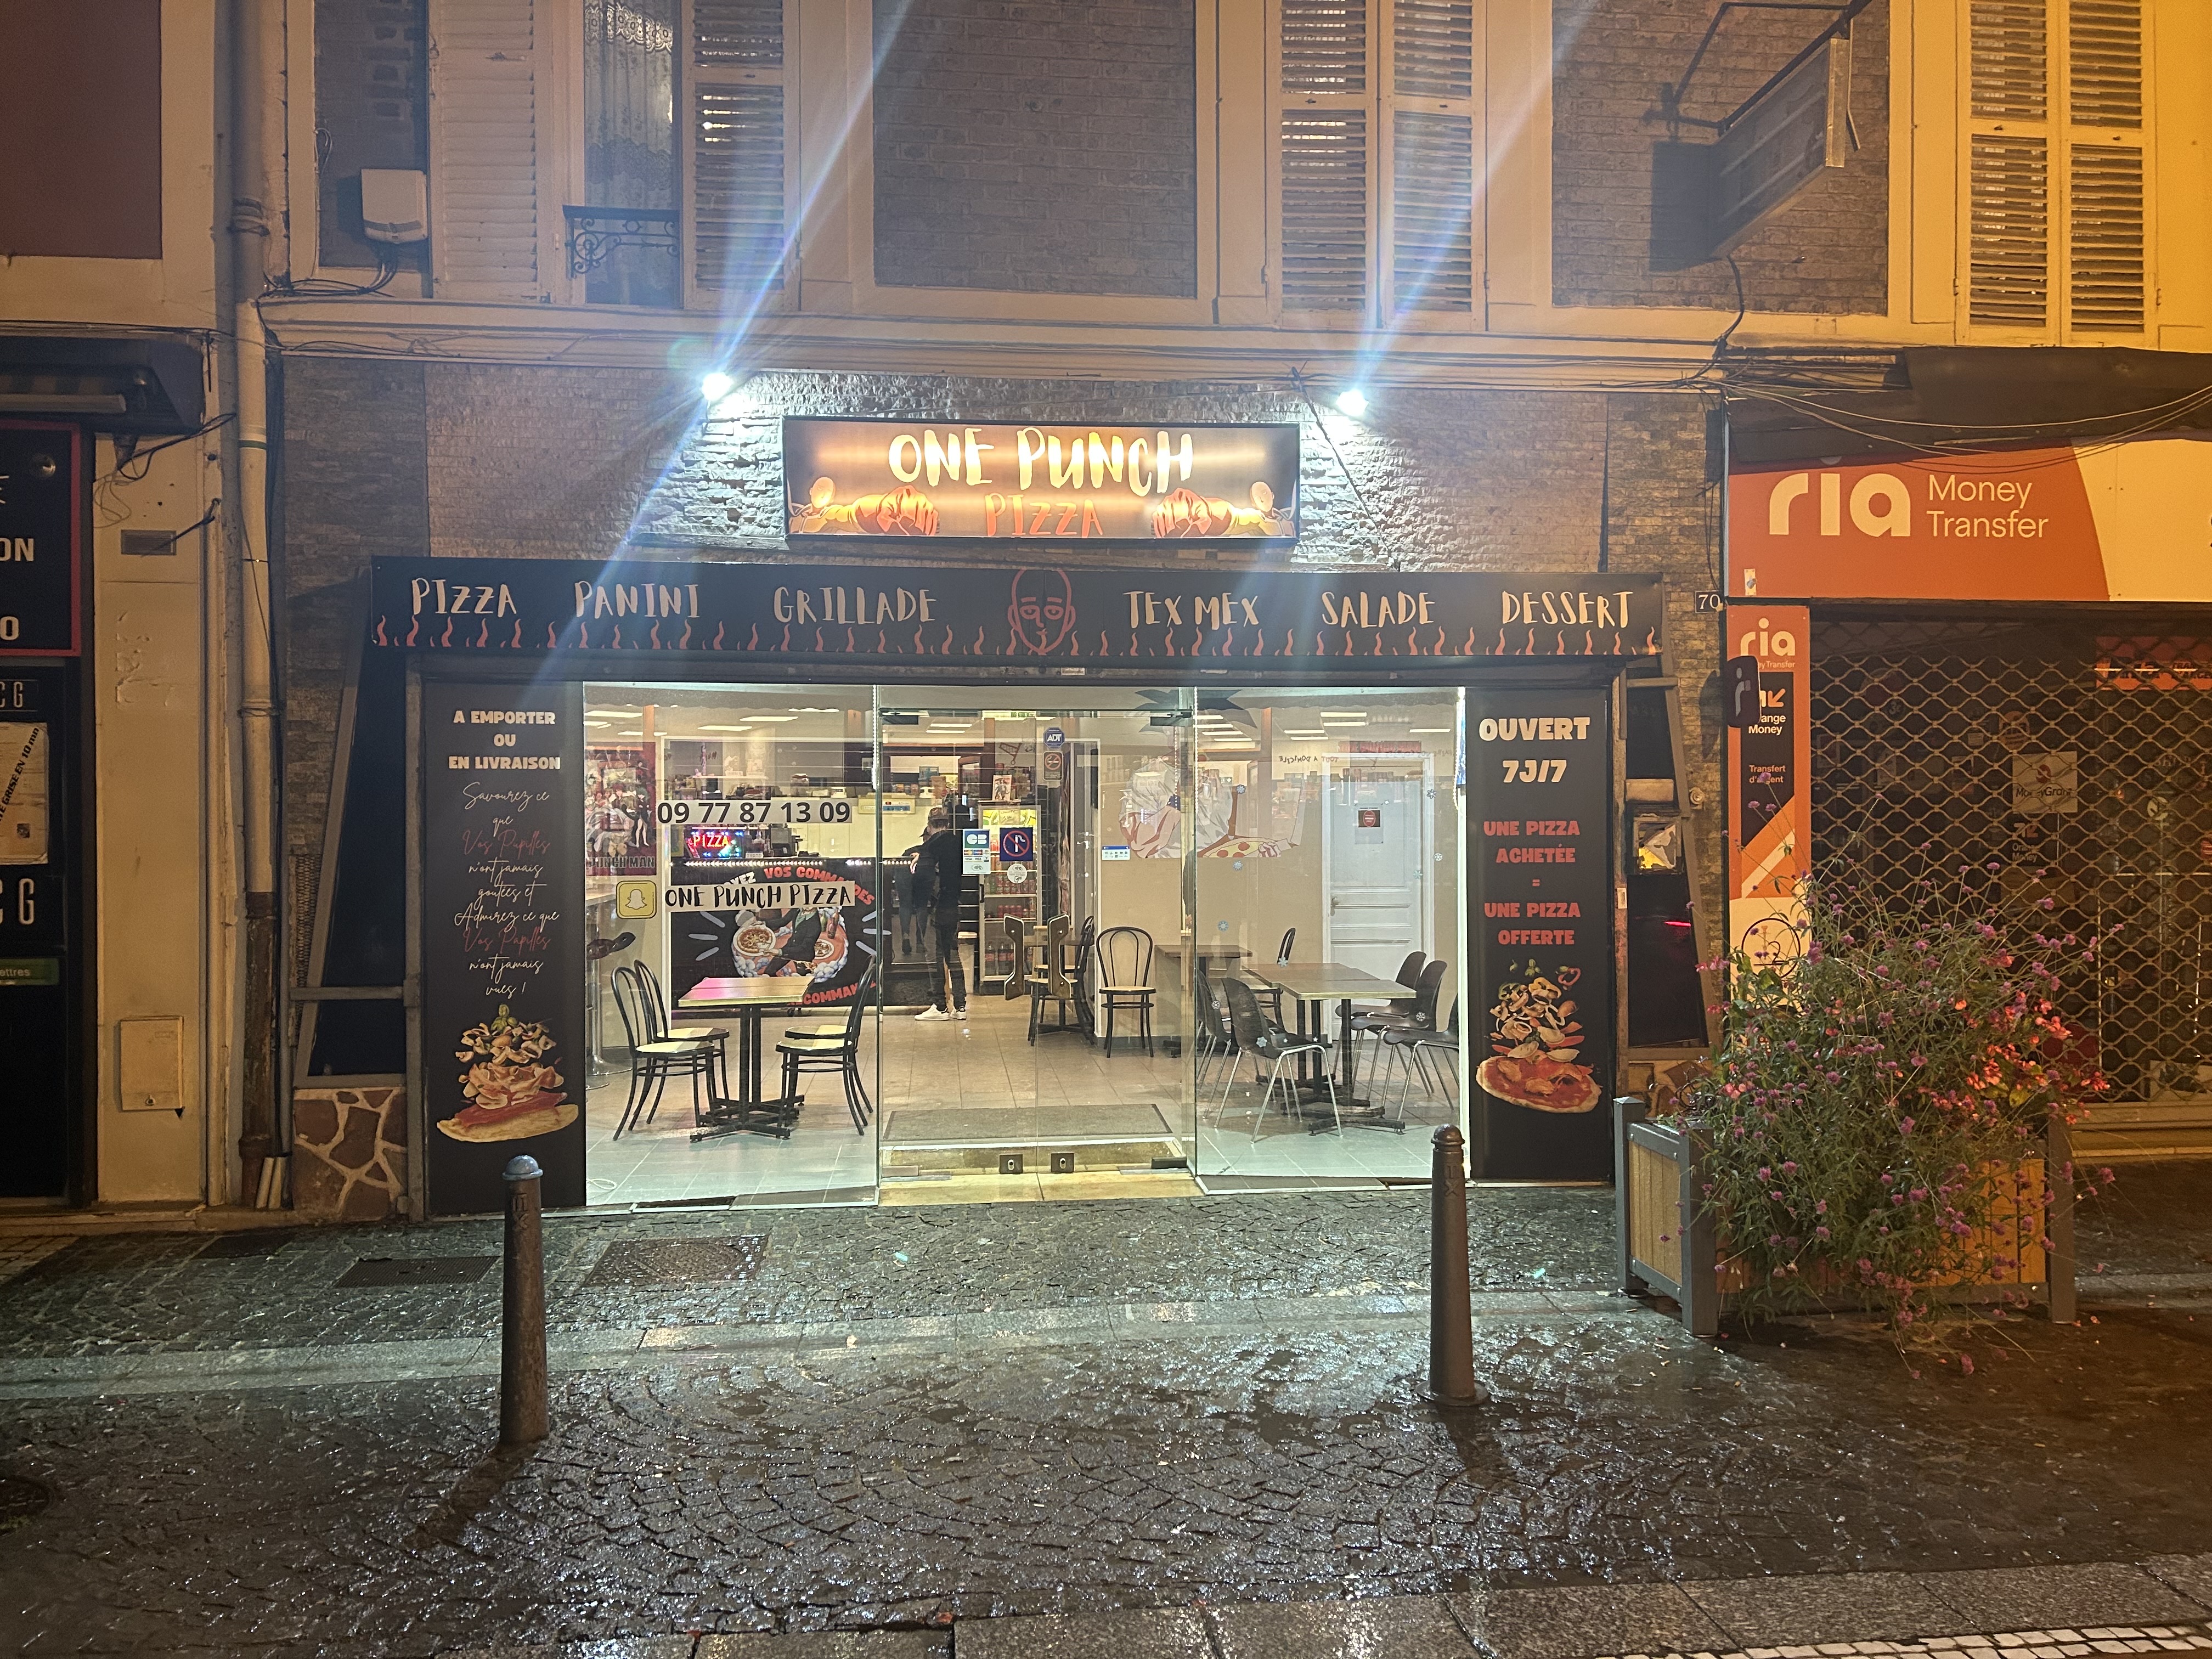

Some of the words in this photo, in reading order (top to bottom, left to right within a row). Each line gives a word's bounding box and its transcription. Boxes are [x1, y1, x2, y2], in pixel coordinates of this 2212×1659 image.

[888, 427, 994, 487] ONE
[1018, 427, 1193, 496] PUNCH
[1929, 475, 2032, 509] Money
[986, 493, 1103, 537] PIZZA
[1769, 473, 1911, 537] ria
[1927, 510, 2049, 538] Transfer
[412, 578, 517, 617] PIZZA
[575, 580, 700, 619] PANINI
[774, 586, 937, 625] GRILLADE
[1123, 590, 1182, 629] TEX
[1195, 591, 1259, 631] MEX
[1323, 590, 1436, 628] SALADE
[1502, 590, 1634, 628] DESSERT
[1699, 594, 1720, 609] 70
[1740, 618, 1796, 656] ria
[1766, 660, 1796, 668] Transfer
[453, 710, 465, 723] A
[471, 711, 555, 724] EMPORTER
[1760, 715, 1786, 724] ange
[1047, 733, 1062, 742] ADT
[1479, 717, 1590, 741] OUVERT
[1748, 725, 1783, 736] Money
[494, 734, 516, 747] OU
[448, 756, 469, 769] EN
[475, 757, 561, 770] LIVRAISON
[1503, 760, 1567, 783] 7J/7
[2, 774, 19, 805] GRISE
[14, 759, 25, 775] EN
[22, 744, 31, 758] 10
[1749, 775, 1784, 785] d'aent
[463, 781, 533, 812] Savourez
[536, 792, 550, 801] ce
[658, 802, 690, 823] 09
[698, 802, 731, 823] 77
[740, 802, 771, 823] 87
[781, 802, 811, 823] 13
[819, 802, 850, 823] 09
[493, 816, 514, 837] que
[1483, 821, 1519, 836] UNE
[1526, 821, 1580, 836] PIZZA
[462, 830, 493, 855] Vos
[693, 834, 730, 848] PIZZA
[2012, 842, 2039, 851] Ora
[629, 856, 655, 867] MAN
[1496, 843, 1576, 864] ACHETÉE
[469, 857, 509, 883] n'ont
[494, 864, 543, 887] jamais
[524, 880, 547, 906] et
[665, 887, 706, 907] ONE
[714, 885, 781, 909] PUNCH
[790, 884, 851, 906] PIZZA
[763, 866, 792, 879] VOS
[796, 866, 875, 905] COMMADES
[454, 902, 520, 932] Admirez
[523, 911, 537, 921] ce
[539, 911, 560, 933] que
[1484, 902, 1520, 918] UNE
[1527, 902, 1581, 918] PIZZA
[463, 927, 493, 952] Vos
[498, 926, 551, 957] Papilles
[1498, 930, 1575, 945] OFFERTE
[469, 953, 510, 980] n'ont
[494, 960, 544, 984] jamais
[486, 985, 516, 999] vues
